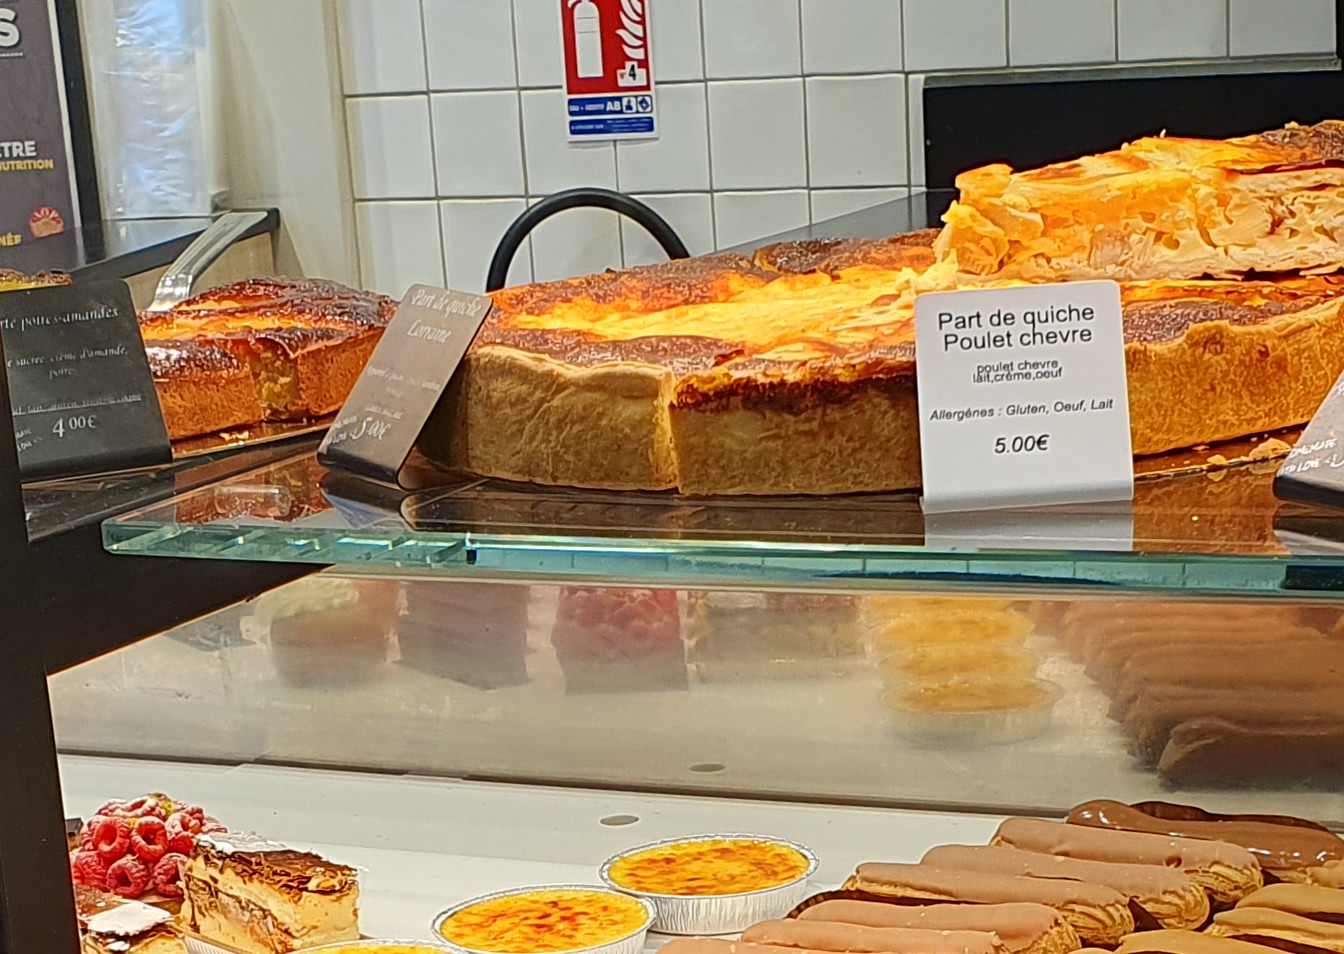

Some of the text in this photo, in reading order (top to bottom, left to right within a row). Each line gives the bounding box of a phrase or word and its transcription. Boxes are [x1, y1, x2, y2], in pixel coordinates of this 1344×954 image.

[628, 64, 637, 81] 4
[605, 101, 622, 111] AB
[938, 304, 1094, 331] Part de quiche
[407, 319, 453, 343] Lorraine
[944, 327, 1093, 352] Poulet chevre
[977, 360, 1059, 376] poulet chevre
[1006, 404, 1049, 416] Gluten,
[1054, 399, 1087, 413] Oeuf,
[1091, 398, 1114, 410] Lait
[994, 434, 1050, 454] 5.00€
